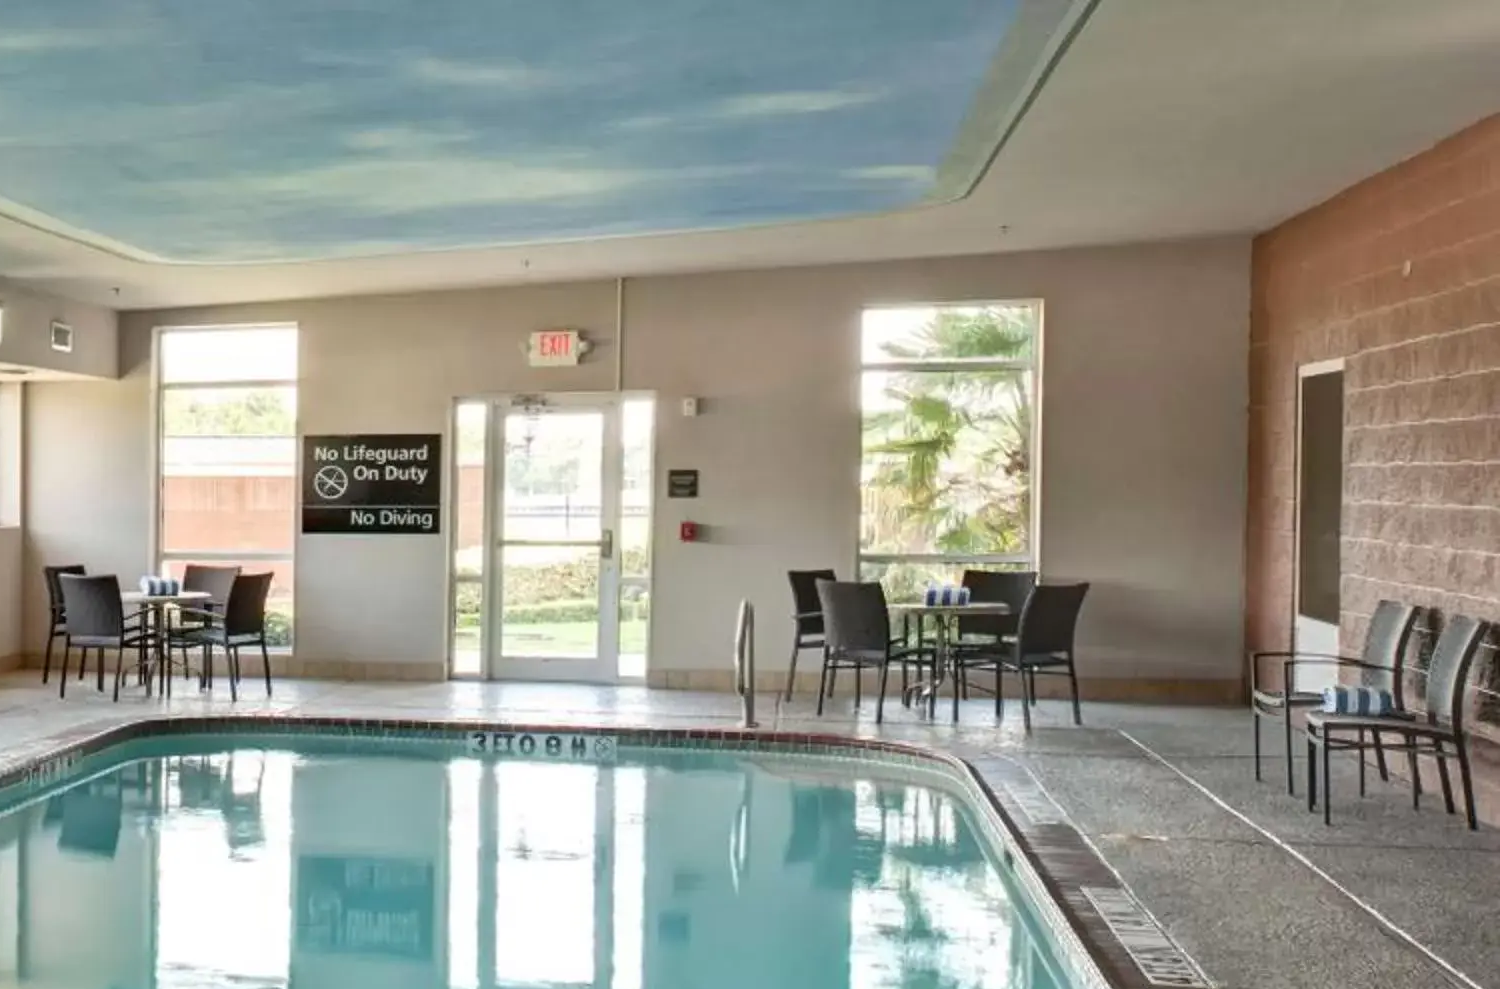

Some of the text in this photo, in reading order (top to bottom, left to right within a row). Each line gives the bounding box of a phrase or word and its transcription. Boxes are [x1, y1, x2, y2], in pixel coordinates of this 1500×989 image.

[540, 334, 570, 357] EXIT
[315, 444, 429, 464] No Lifeguard
[353, 465, 429, 484] On Duty
[350, 509, 433, 529] No Diving
